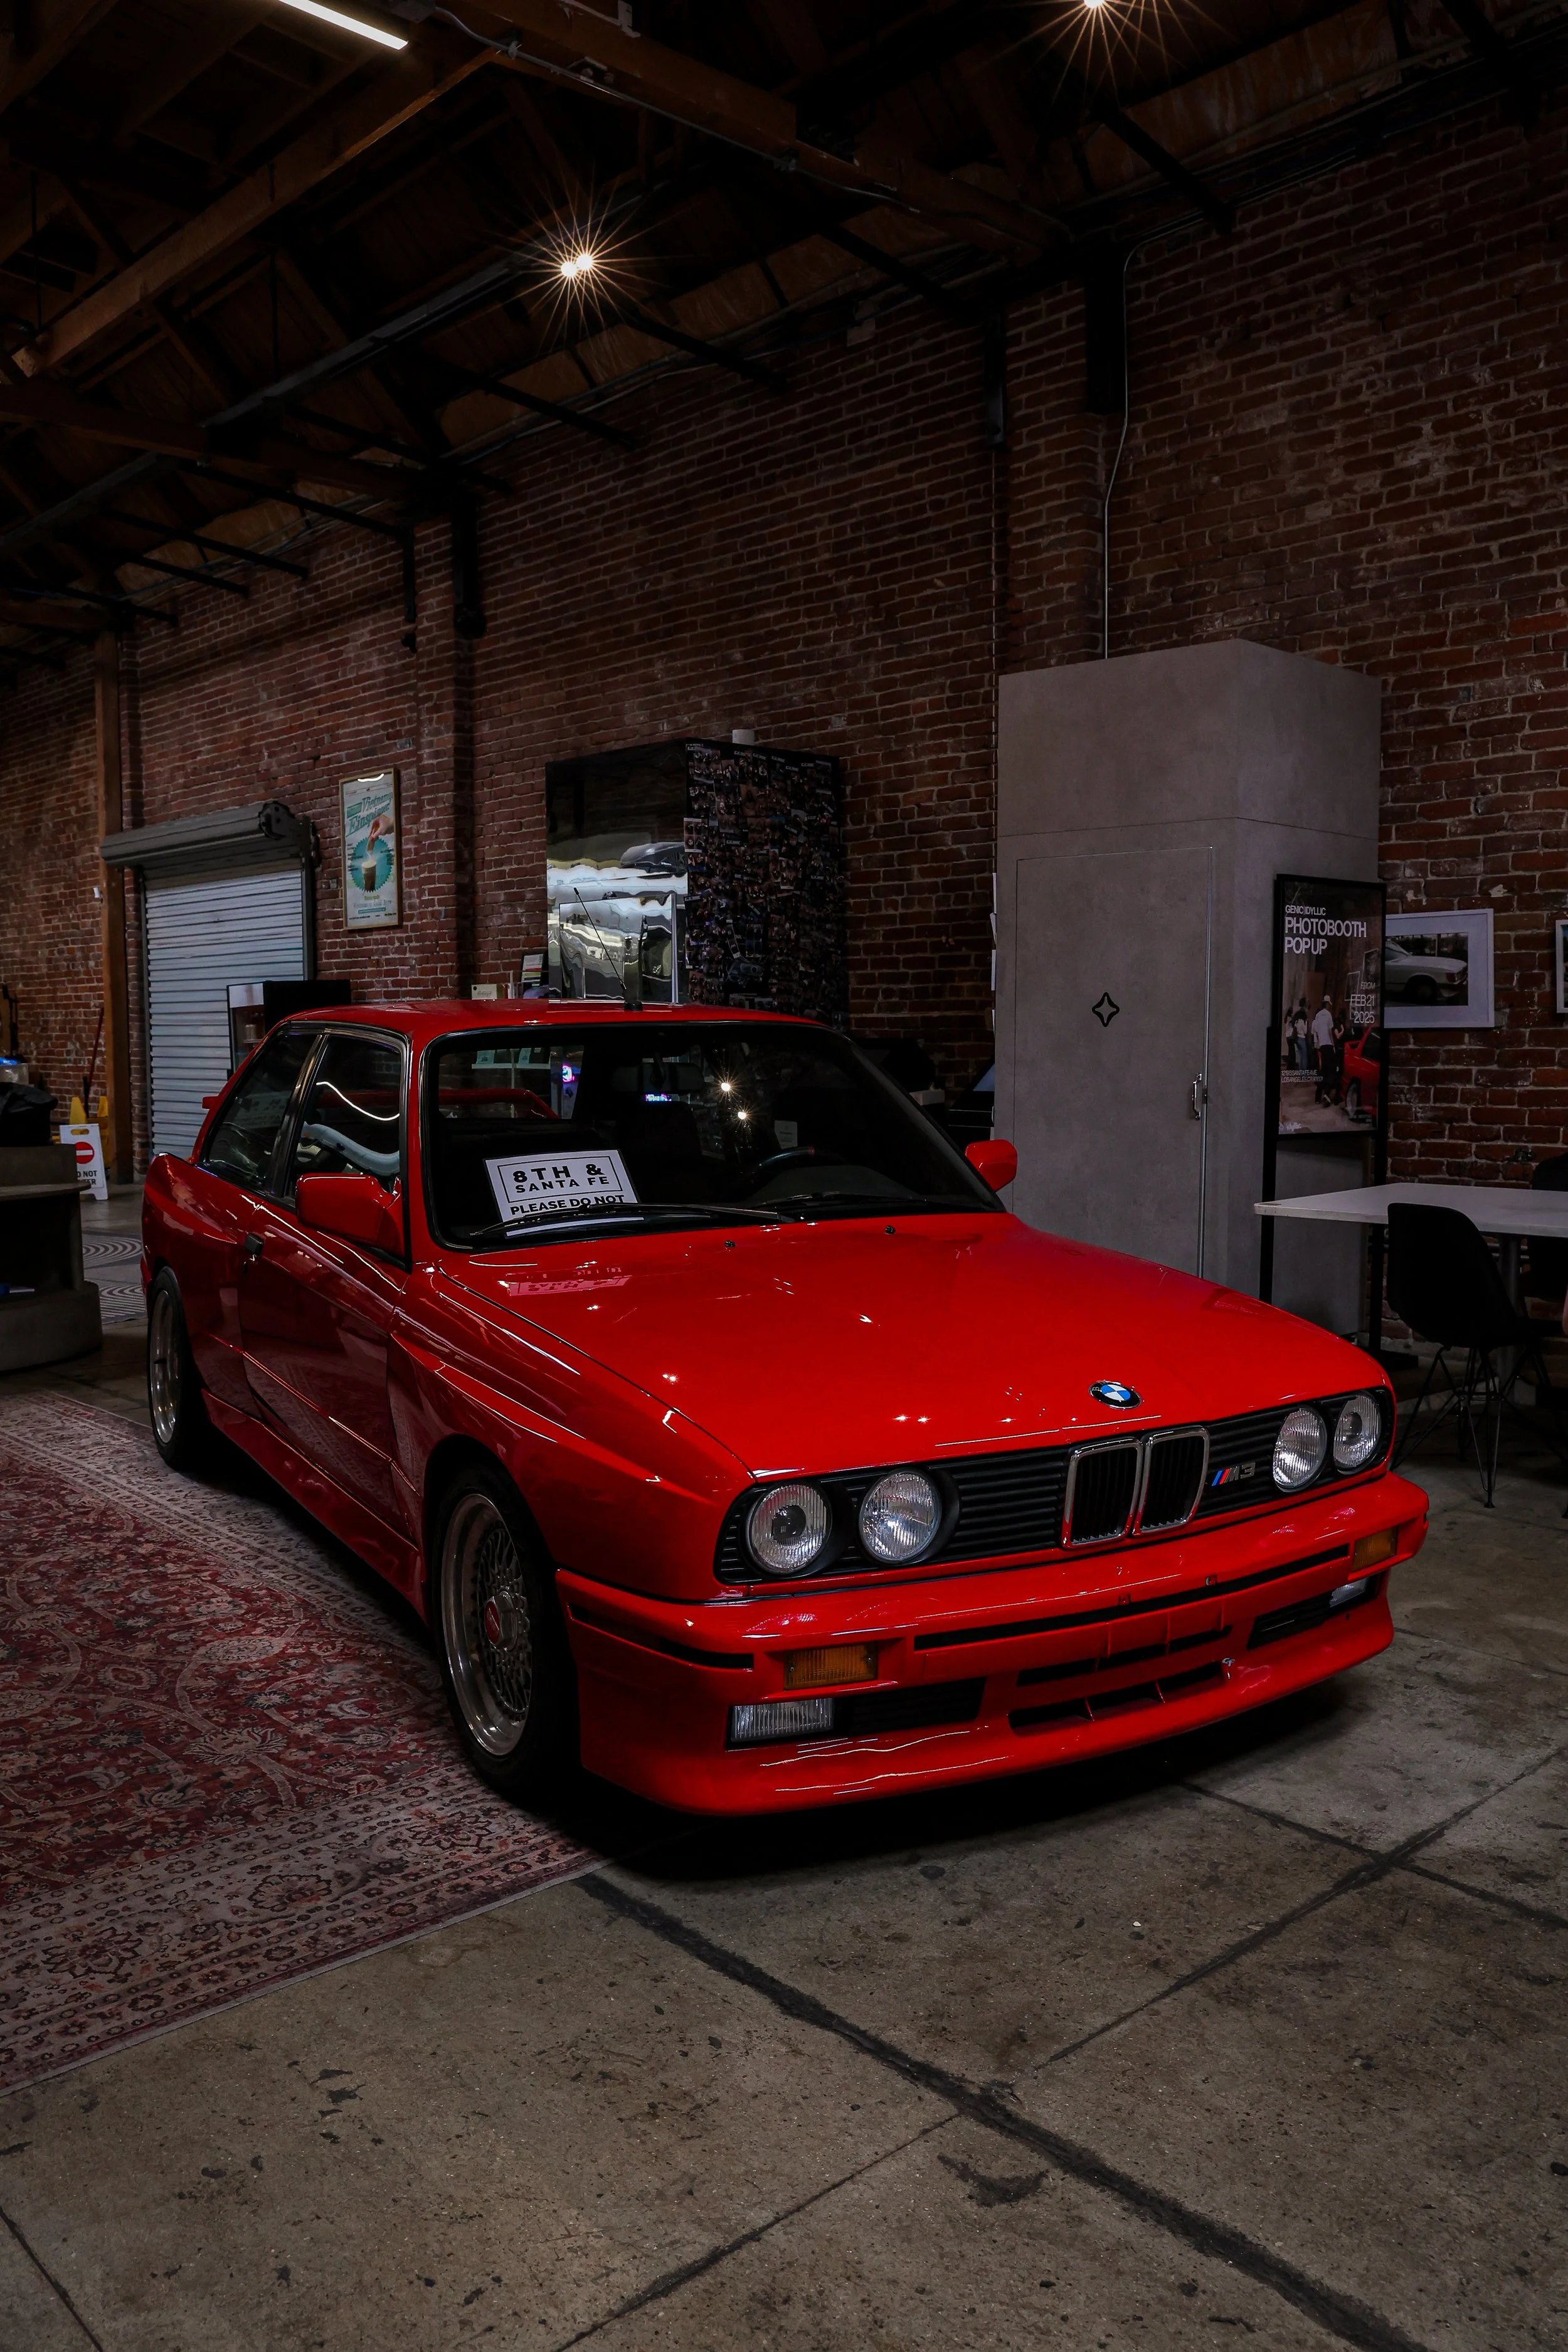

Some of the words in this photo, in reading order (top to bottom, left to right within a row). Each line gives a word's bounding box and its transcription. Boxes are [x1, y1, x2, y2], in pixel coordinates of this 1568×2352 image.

[1285, 916, 1367, 938] PHOTOBOOTH
[1353, 1011, 1375, 1024] 2025
[512, 1165, 571, 1183] 8TH
[586, 1163, 605, 1176] &
[516, 1179, 580, 1193] SANTA
[587, 1177, 610, 1185] FE
[510, 1199, 567, 1216] PLEASE
[569, 1197, 591, 1207] DO
[595, 1195, 625, 1205] NOT
